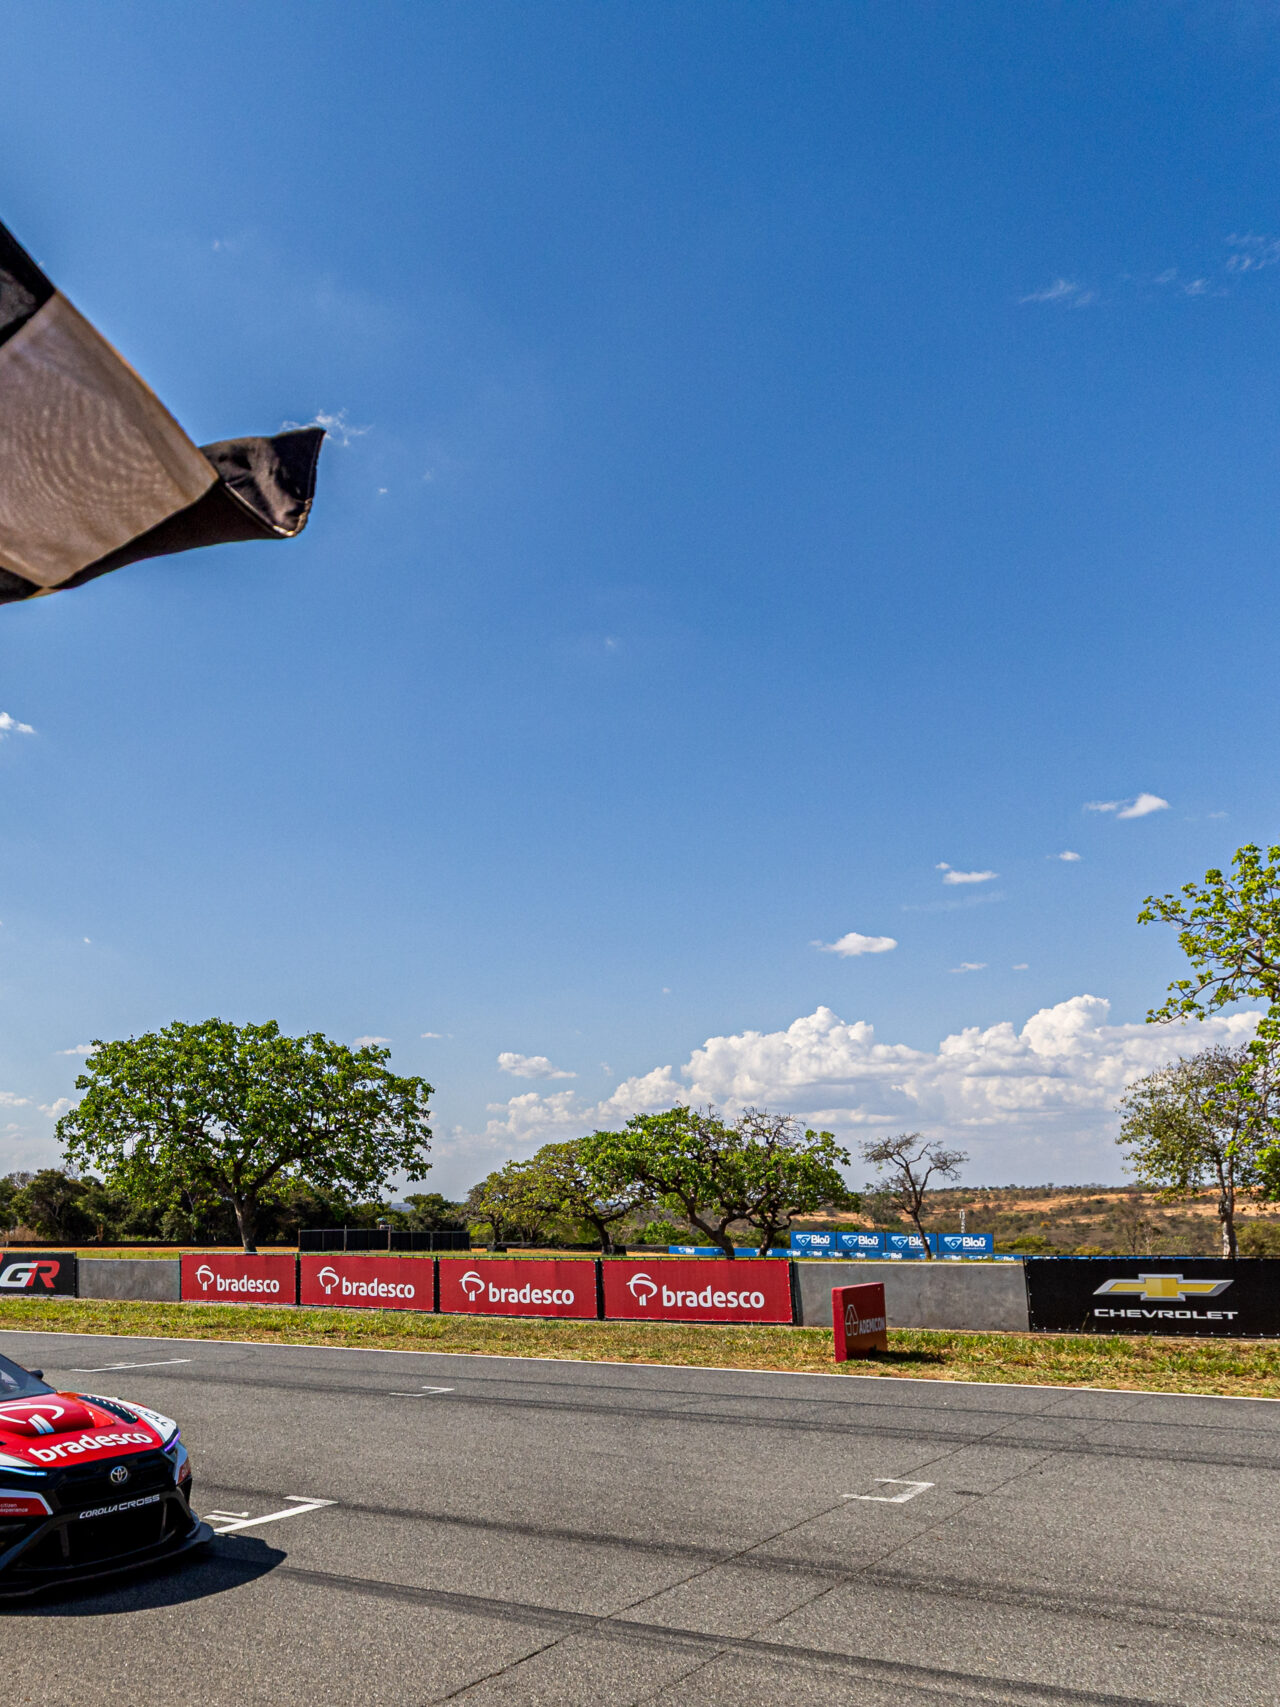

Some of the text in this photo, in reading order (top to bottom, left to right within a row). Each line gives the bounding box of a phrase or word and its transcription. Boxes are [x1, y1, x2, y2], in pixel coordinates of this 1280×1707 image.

[216, 1274, 280, 1293] bradesco
[342, 1277, 415, 1299] bradesco
[488, 1281, 575, 1305] bradesco
[662, 1284, 765, 1309] bradesco
[1094, 1308, 1239, 1320] CHEVROLET
[28, 1433, 153, 1462] bradesco
[80, 1494, 161, 1519] COROLLA CROSS
